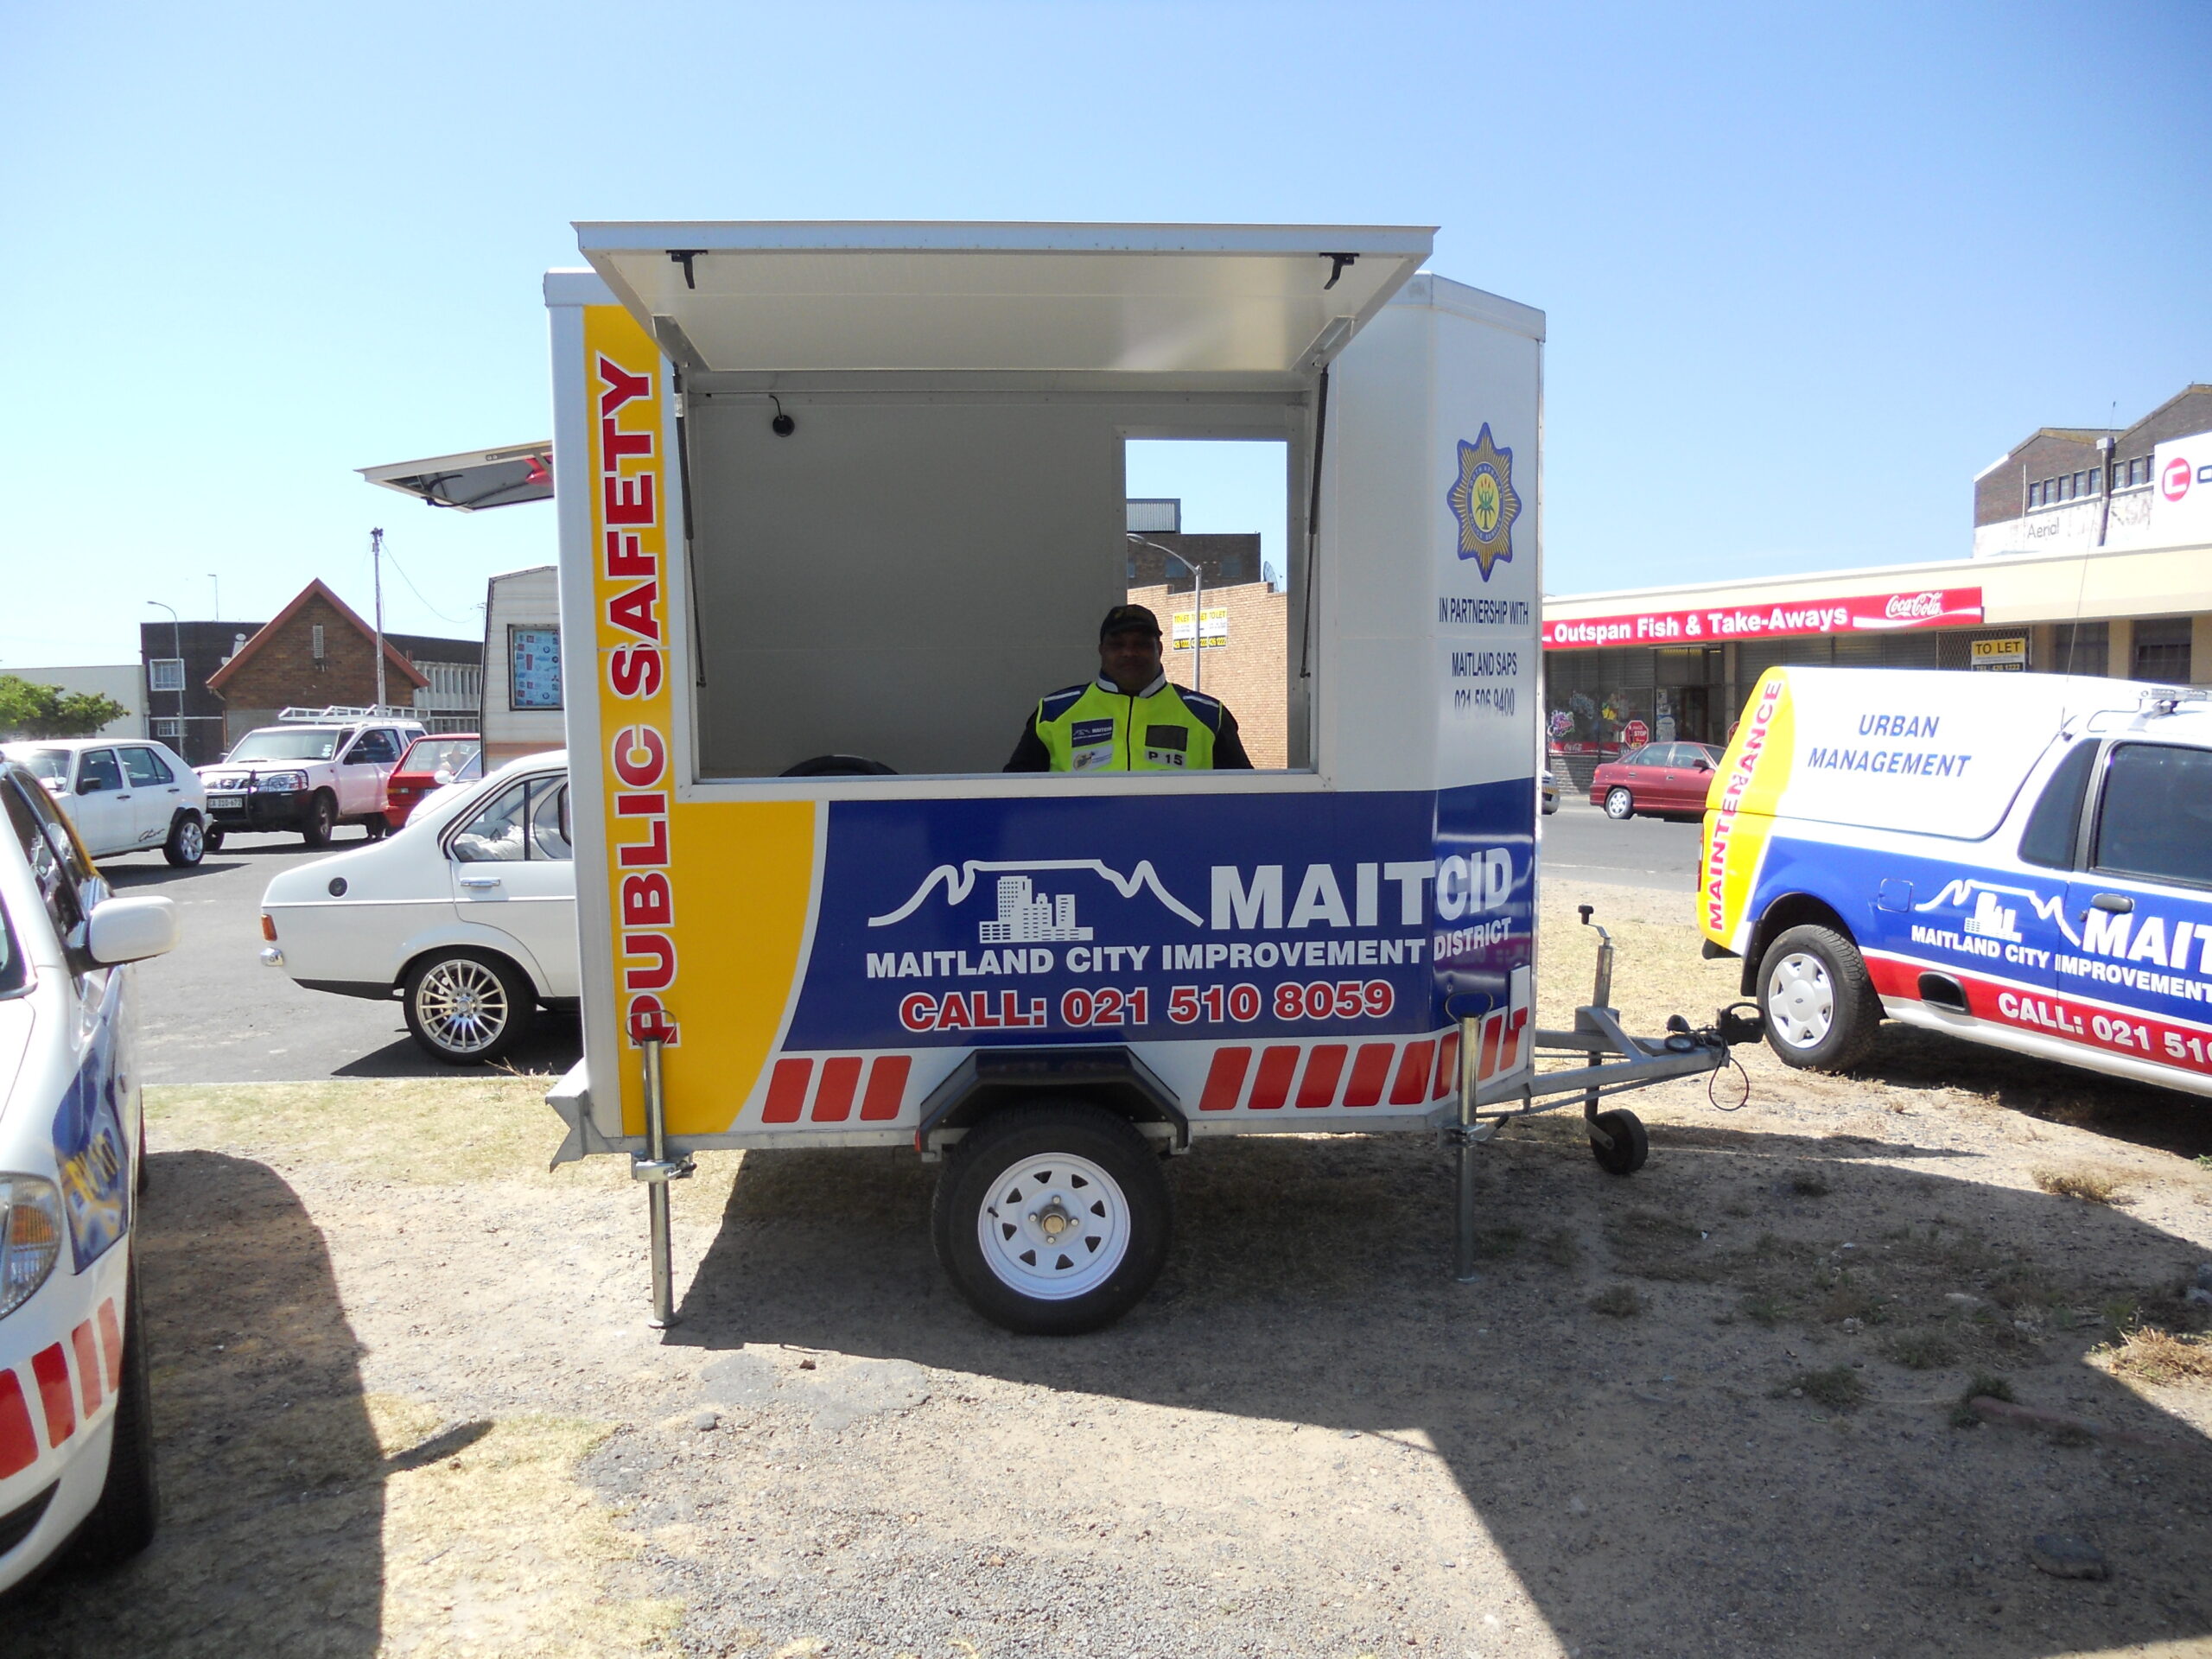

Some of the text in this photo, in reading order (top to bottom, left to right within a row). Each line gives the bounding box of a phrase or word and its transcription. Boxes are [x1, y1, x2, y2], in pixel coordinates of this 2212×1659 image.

[595, 349, 664, 701] SAFETY
[2027, 517, 2060, 539] Aerial
[1439, 597, 1529, 625] IN PARTNERSHIP WITH
[1554, 592, 1942, 645] Outspan Fish & Take-Aways Coca-Cola
[1452, 652, 1517, 677] MAITLAND SAPS
[1976, 641, 2020, 655] TO LET
[1859, 714, 1941, 738] URBAN
[1148, 751, 1183, 766] P 15
[1808, 747, 1972, 778] MANAGEMENT
[1709, 682, 1782, 931] MAINTENANCE
[611, 724, 681, 1049] PUBLIC
[867, 948, 1055, 979] MAITLAND
[1065, 945, 1151, 974] CITY
[1162, 938, 1426, 970] IMPROVEMENT
[1433, 917, 1512, 962] DISTRICT
[1911, 925, 2001, 959] MAITLAND
[2005, 945, 2050, 969] CITY
[899, 979, 1395, 1033] CALL: 021 510 8059
[1998, 993, 2212, 1064] CALL: 021 51
